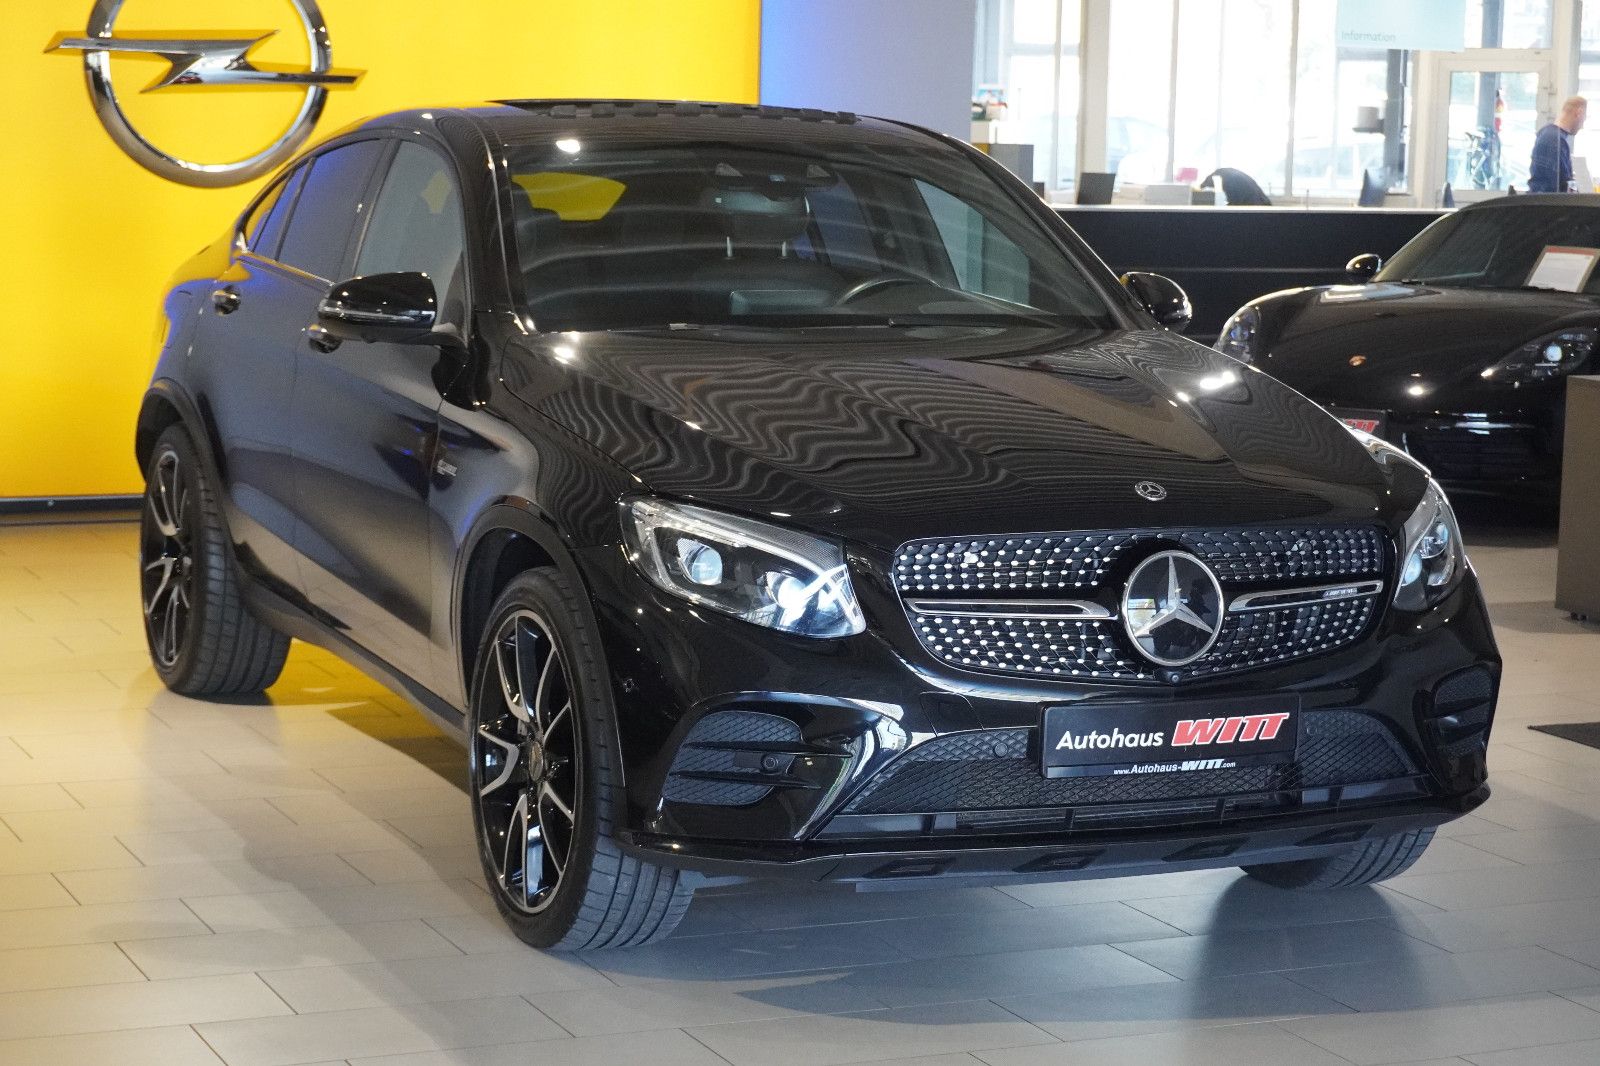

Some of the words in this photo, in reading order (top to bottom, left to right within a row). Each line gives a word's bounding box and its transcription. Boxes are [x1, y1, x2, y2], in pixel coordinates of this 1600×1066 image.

[1341, 30, 1396, 42] Information
[1056, 727, 1164, 750] Autohaus
[1171, 712, 1290, 747] WITT
[1113, 758, 1236, 775] www.Autohaus-WITT.com
